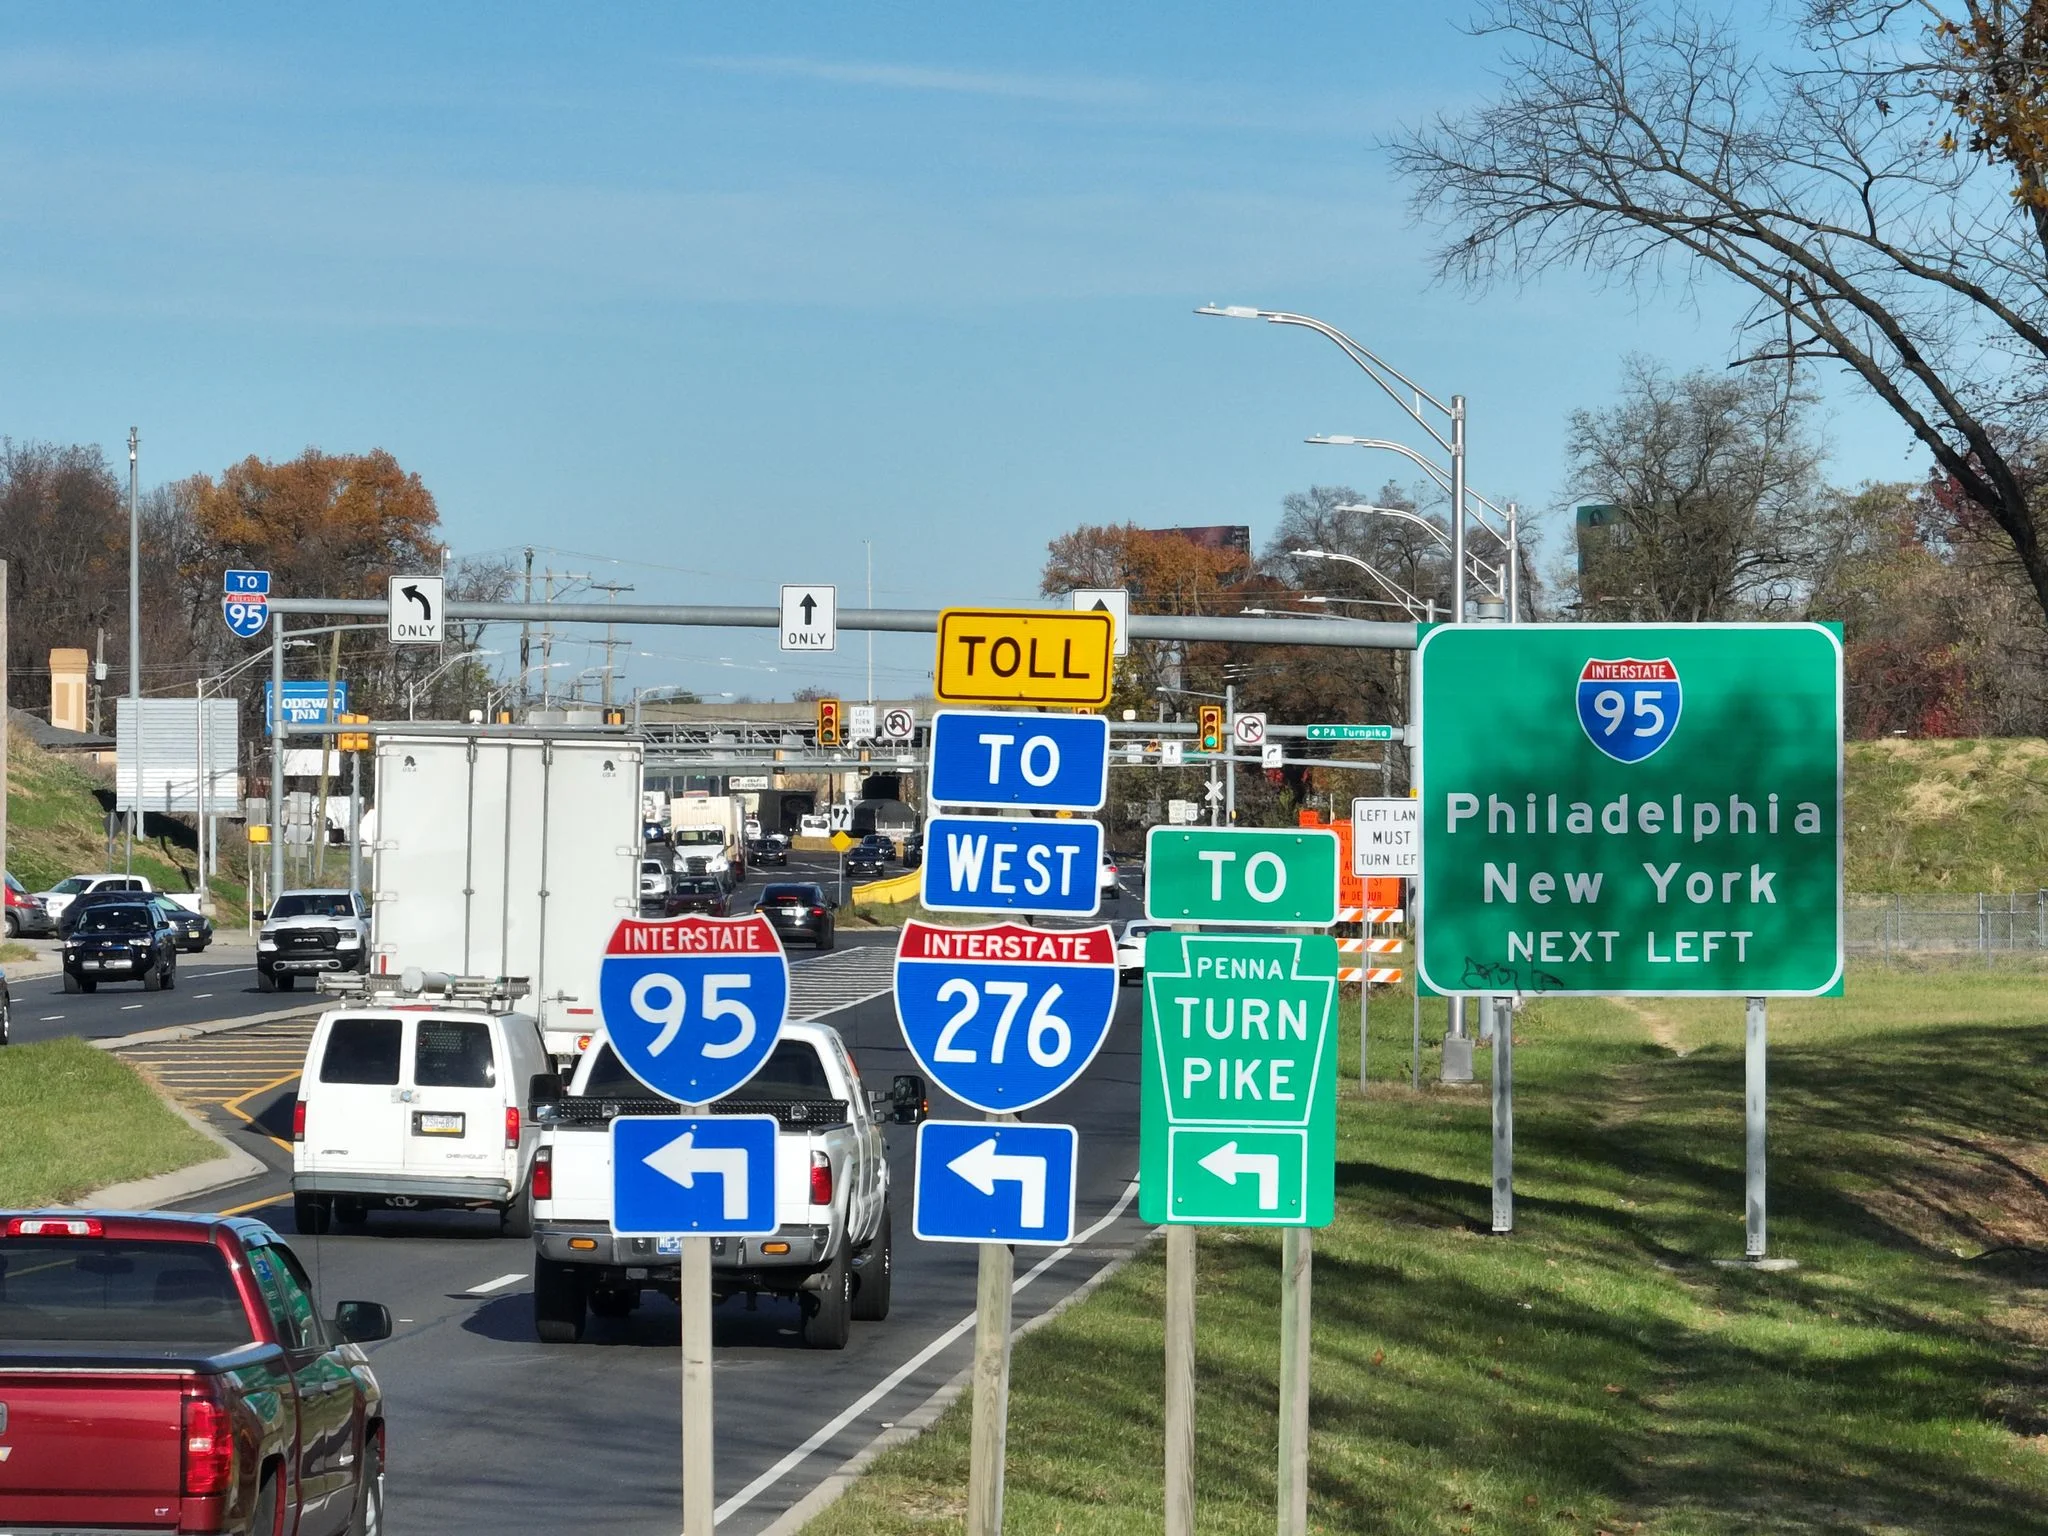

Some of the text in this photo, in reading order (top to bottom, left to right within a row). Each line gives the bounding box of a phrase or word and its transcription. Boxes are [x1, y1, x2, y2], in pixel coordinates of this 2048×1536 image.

[237, 575, 258, 588] TO
[229, 604, 263, 629] 95
[398, 625, 435, 637] ONLY
[789, 633, 826, 645] ONLY
[958, 635, 1090, 680] TOLL
[1592, 664, 1666, 678] INTERSTATE
[290, 709, 320, 722] INN
[1594, 690, 1664, 737] 95
[1323, 728, 1387, 739] PA Turnpike
[979, 733, 1060, 787] TO
[1360, 810, 1416, 822] LEFT LAN
[1447, 792, 1821, 843] Philadelphia
[1373, 830, 1411, 845] MUST
[946, 832, 1081, 897] WEST
[1360, 854, 1390, 866] TURN
[1396, 854, 1417, 866] LEF
[1198, 850, 1287, 903] TO
[1483, 862, 1777, 904] New York
[624, 926, 760, 951] INTERSTATE
[923, 933, 1092, 961] INTERSTATE
[1508, 931, 1753, 963] NEXT LEFT
[1197, 957, 1284, 980] PENNA
[630, 972, 757, 1059] 95
[933, 978, 1072, 1068] 276
[1174, 997, 1307, 1041] TURN
[1183, 1057, 1295, 1101] PIKE
[155, 1507, 169, 1516] LT
